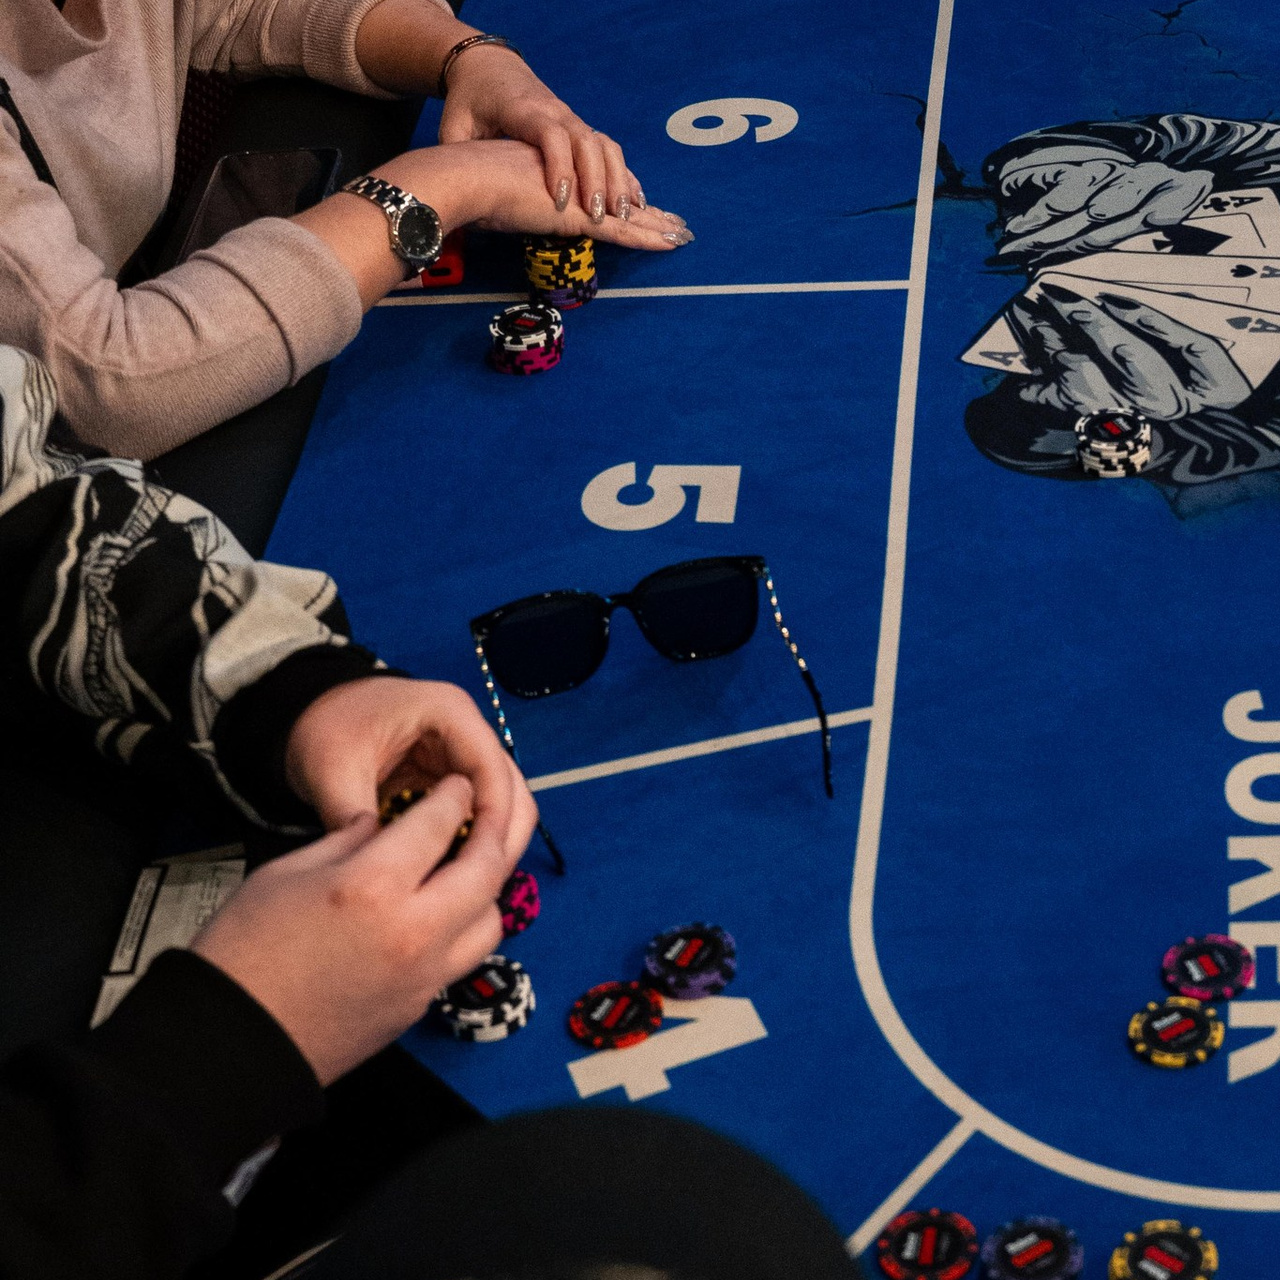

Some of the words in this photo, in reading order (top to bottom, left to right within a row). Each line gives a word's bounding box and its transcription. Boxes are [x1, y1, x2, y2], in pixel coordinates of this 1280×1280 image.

[665, 97, 799, 147] 6
[1229, 195, 1265, 209] A
[978, 350, 1024, 367] A
[581, 460, 743, 532] 5
